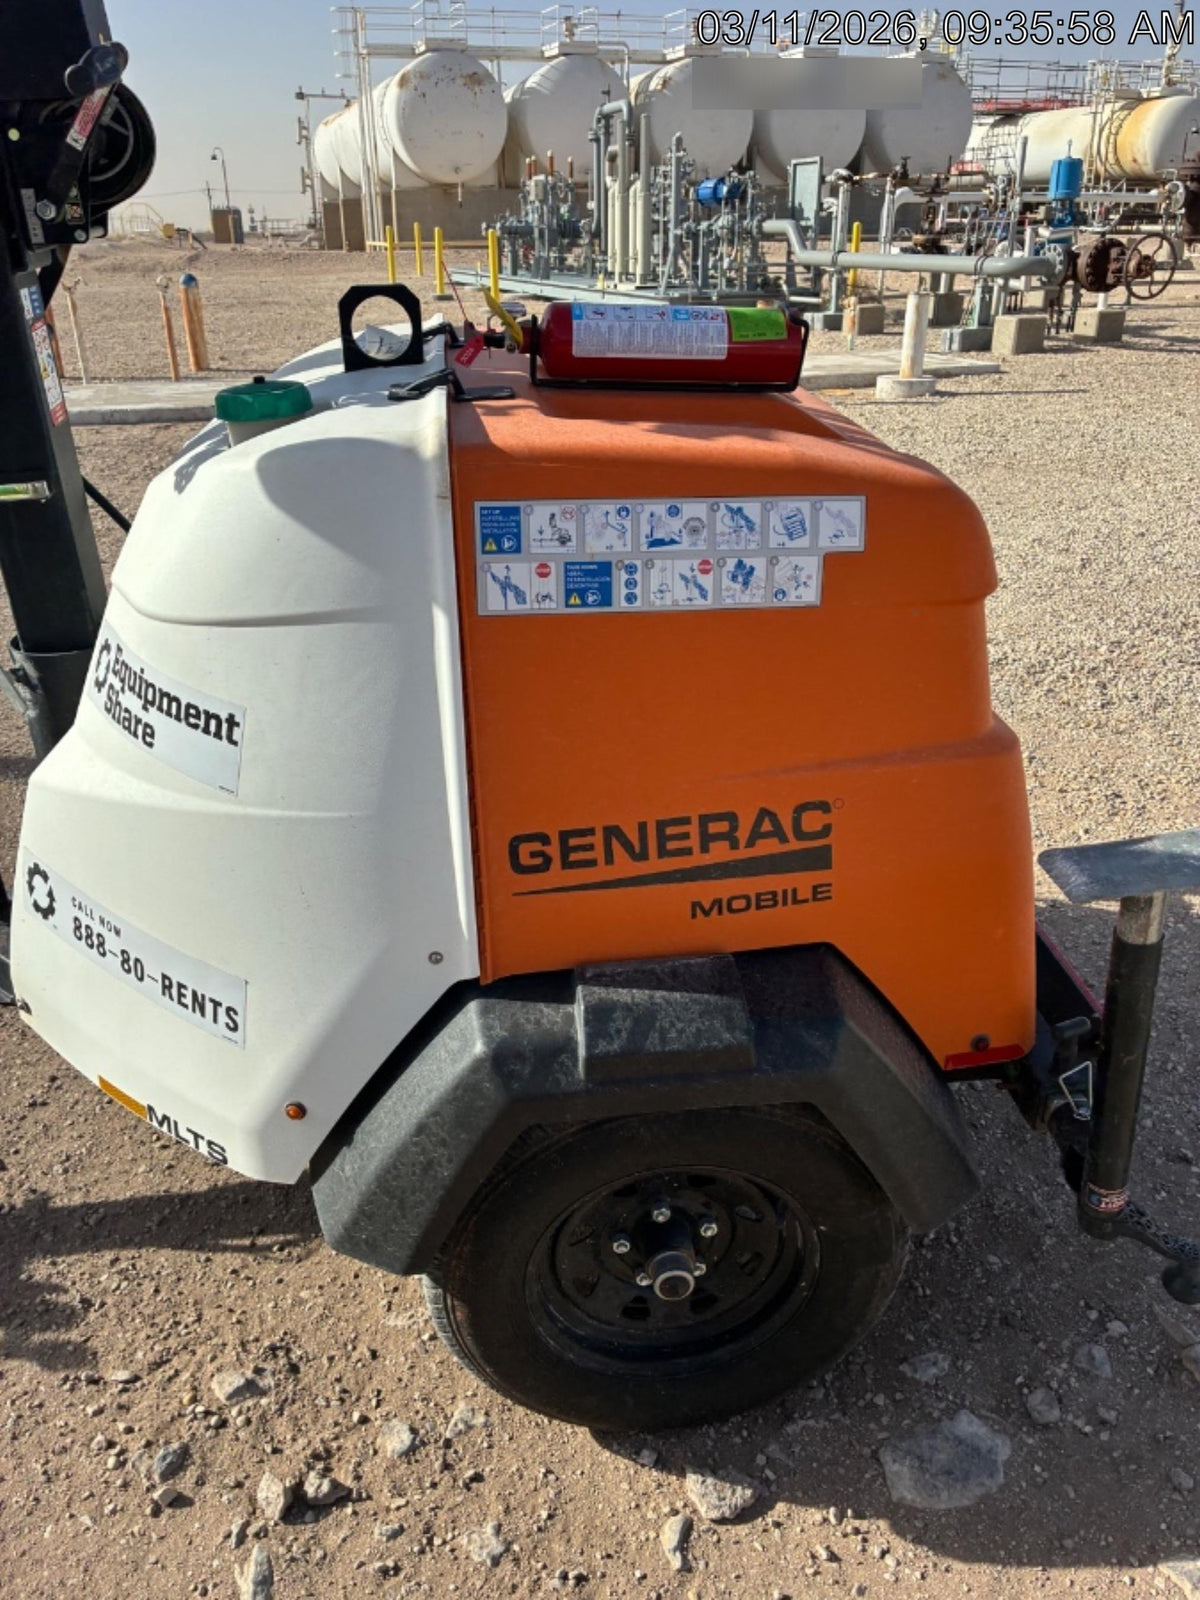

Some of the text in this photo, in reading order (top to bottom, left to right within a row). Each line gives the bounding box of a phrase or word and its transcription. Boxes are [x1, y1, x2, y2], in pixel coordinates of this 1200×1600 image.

[104, 682, 156, 749] Share
[111, 643, 241, 747] Equipment
[508, 799, 833, 875] GENERAC
[71, 896, 122, 938] CALL NOW
[690, 882, 833, 920] MOBILE
[72, 915, 240, 1034] 888-80-RENTS
[146, 1103, 229, 1166] MLTS
